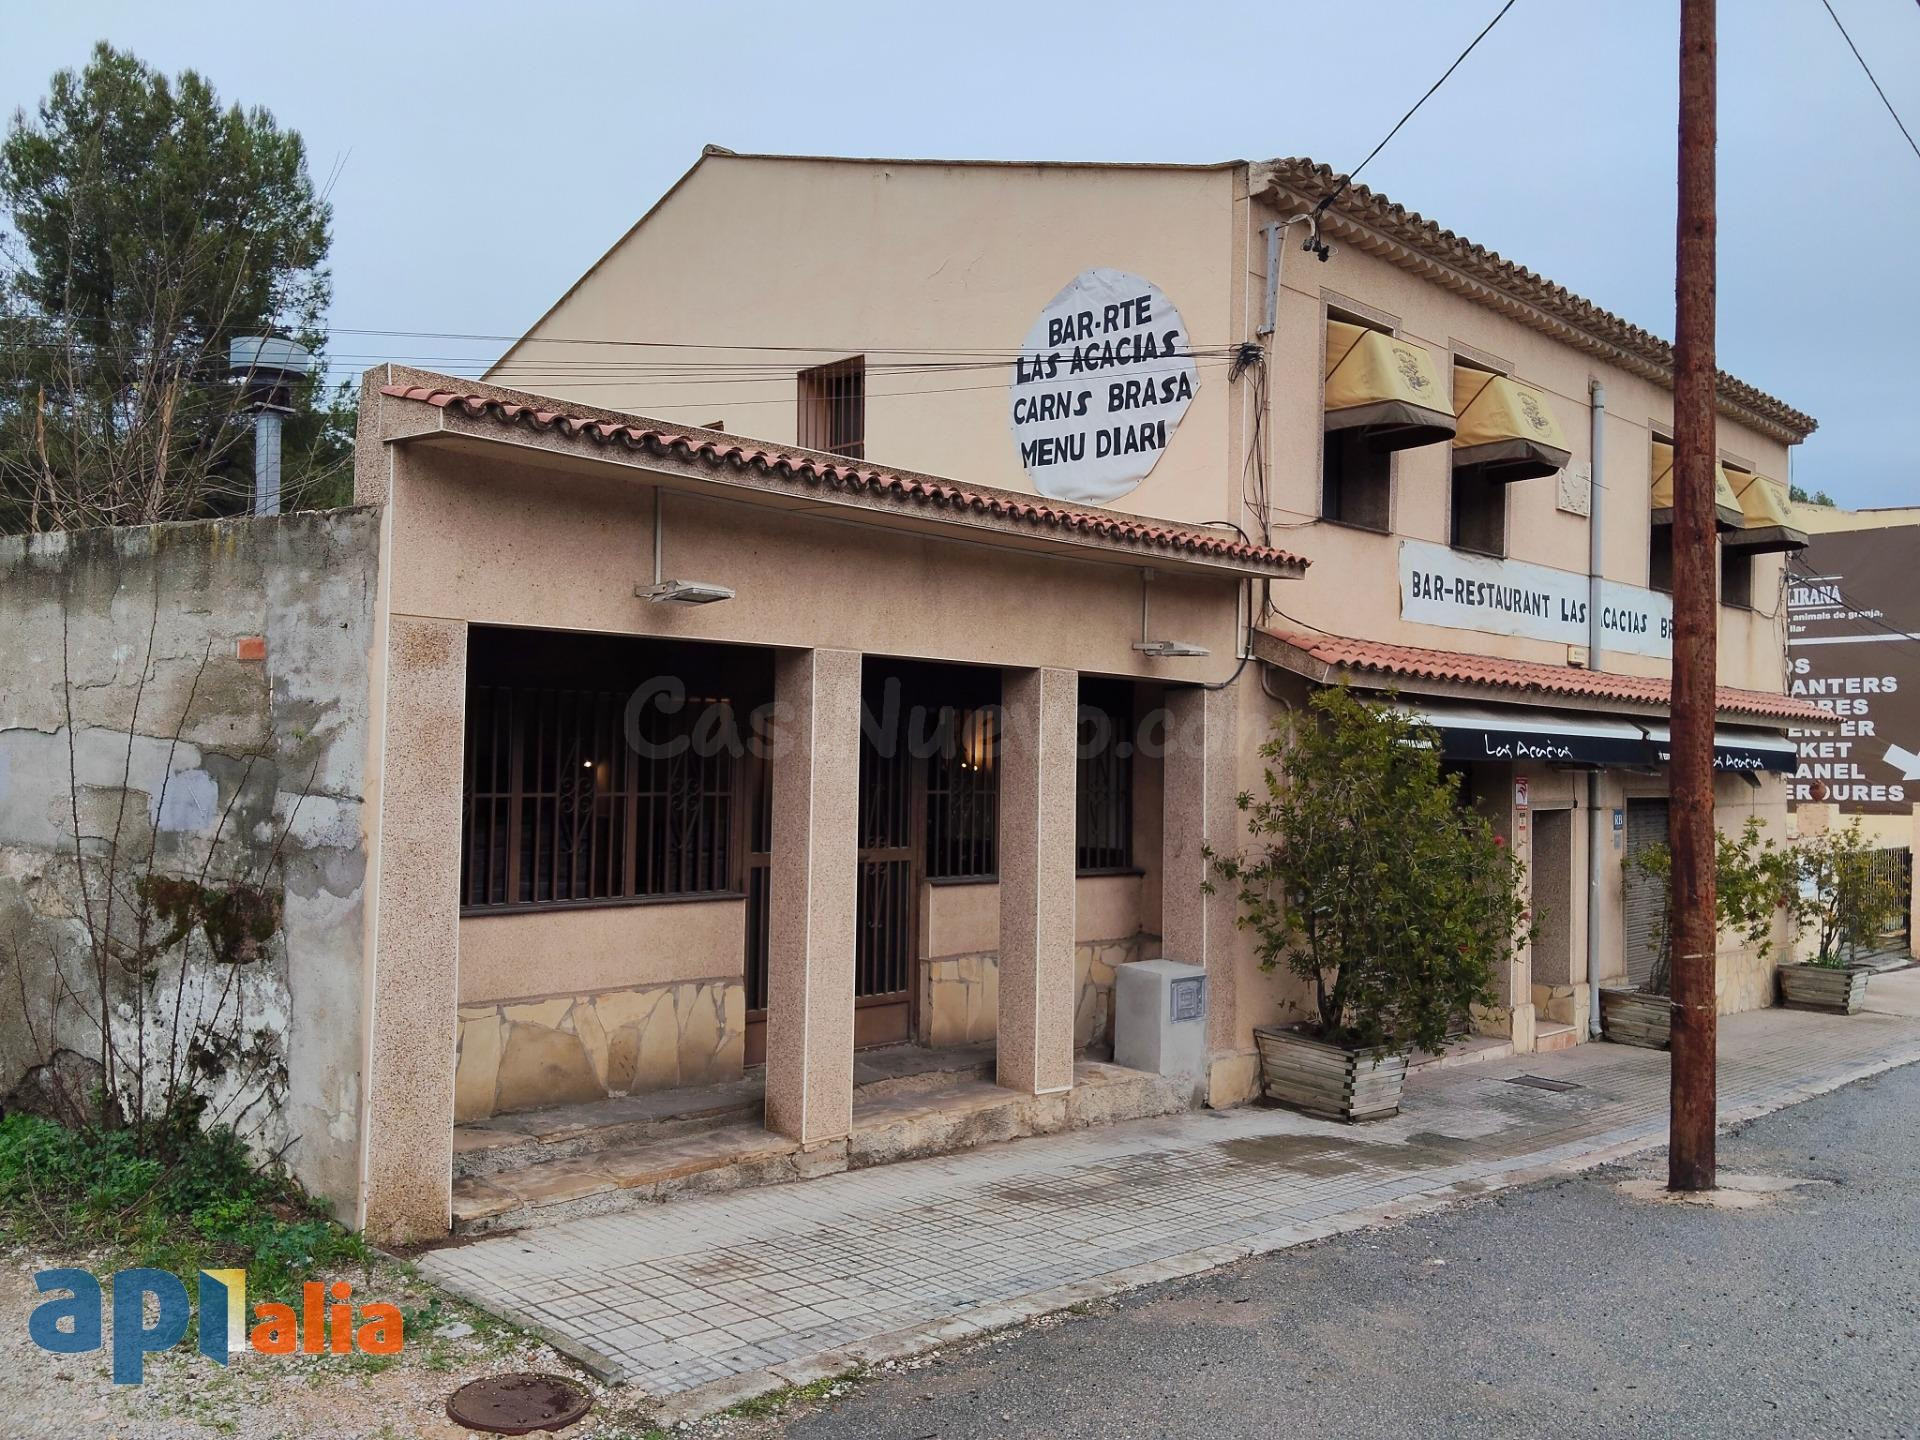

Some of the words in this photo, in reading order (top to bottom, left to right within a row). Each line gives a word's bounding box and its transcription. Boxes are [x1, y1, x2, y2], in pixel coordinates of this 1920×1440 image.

[1016, 353, 1060, 385] LAS
[1069, 330, 1179, 375] ACACIAS
[1013, 390, 1092, 425] CARNS
[1107, 371, 1192, 413] BRASA
[1020, 432, 1085, 468] MENU
[1096, 420, 1166, 459] DIARI
[1411, 570, 1550, 618] BAR-RESTAURANT
[1561, 598, 1587, 624] LAS
[1600, 607, 1648, 635] CACIAS
[1484, 733, 1513, 759] Las
[1516, 739, 1574, 759] Acacias
[1796, 742, 1853, 758] KET
[1787, 763, 1866, 780] ANEL
